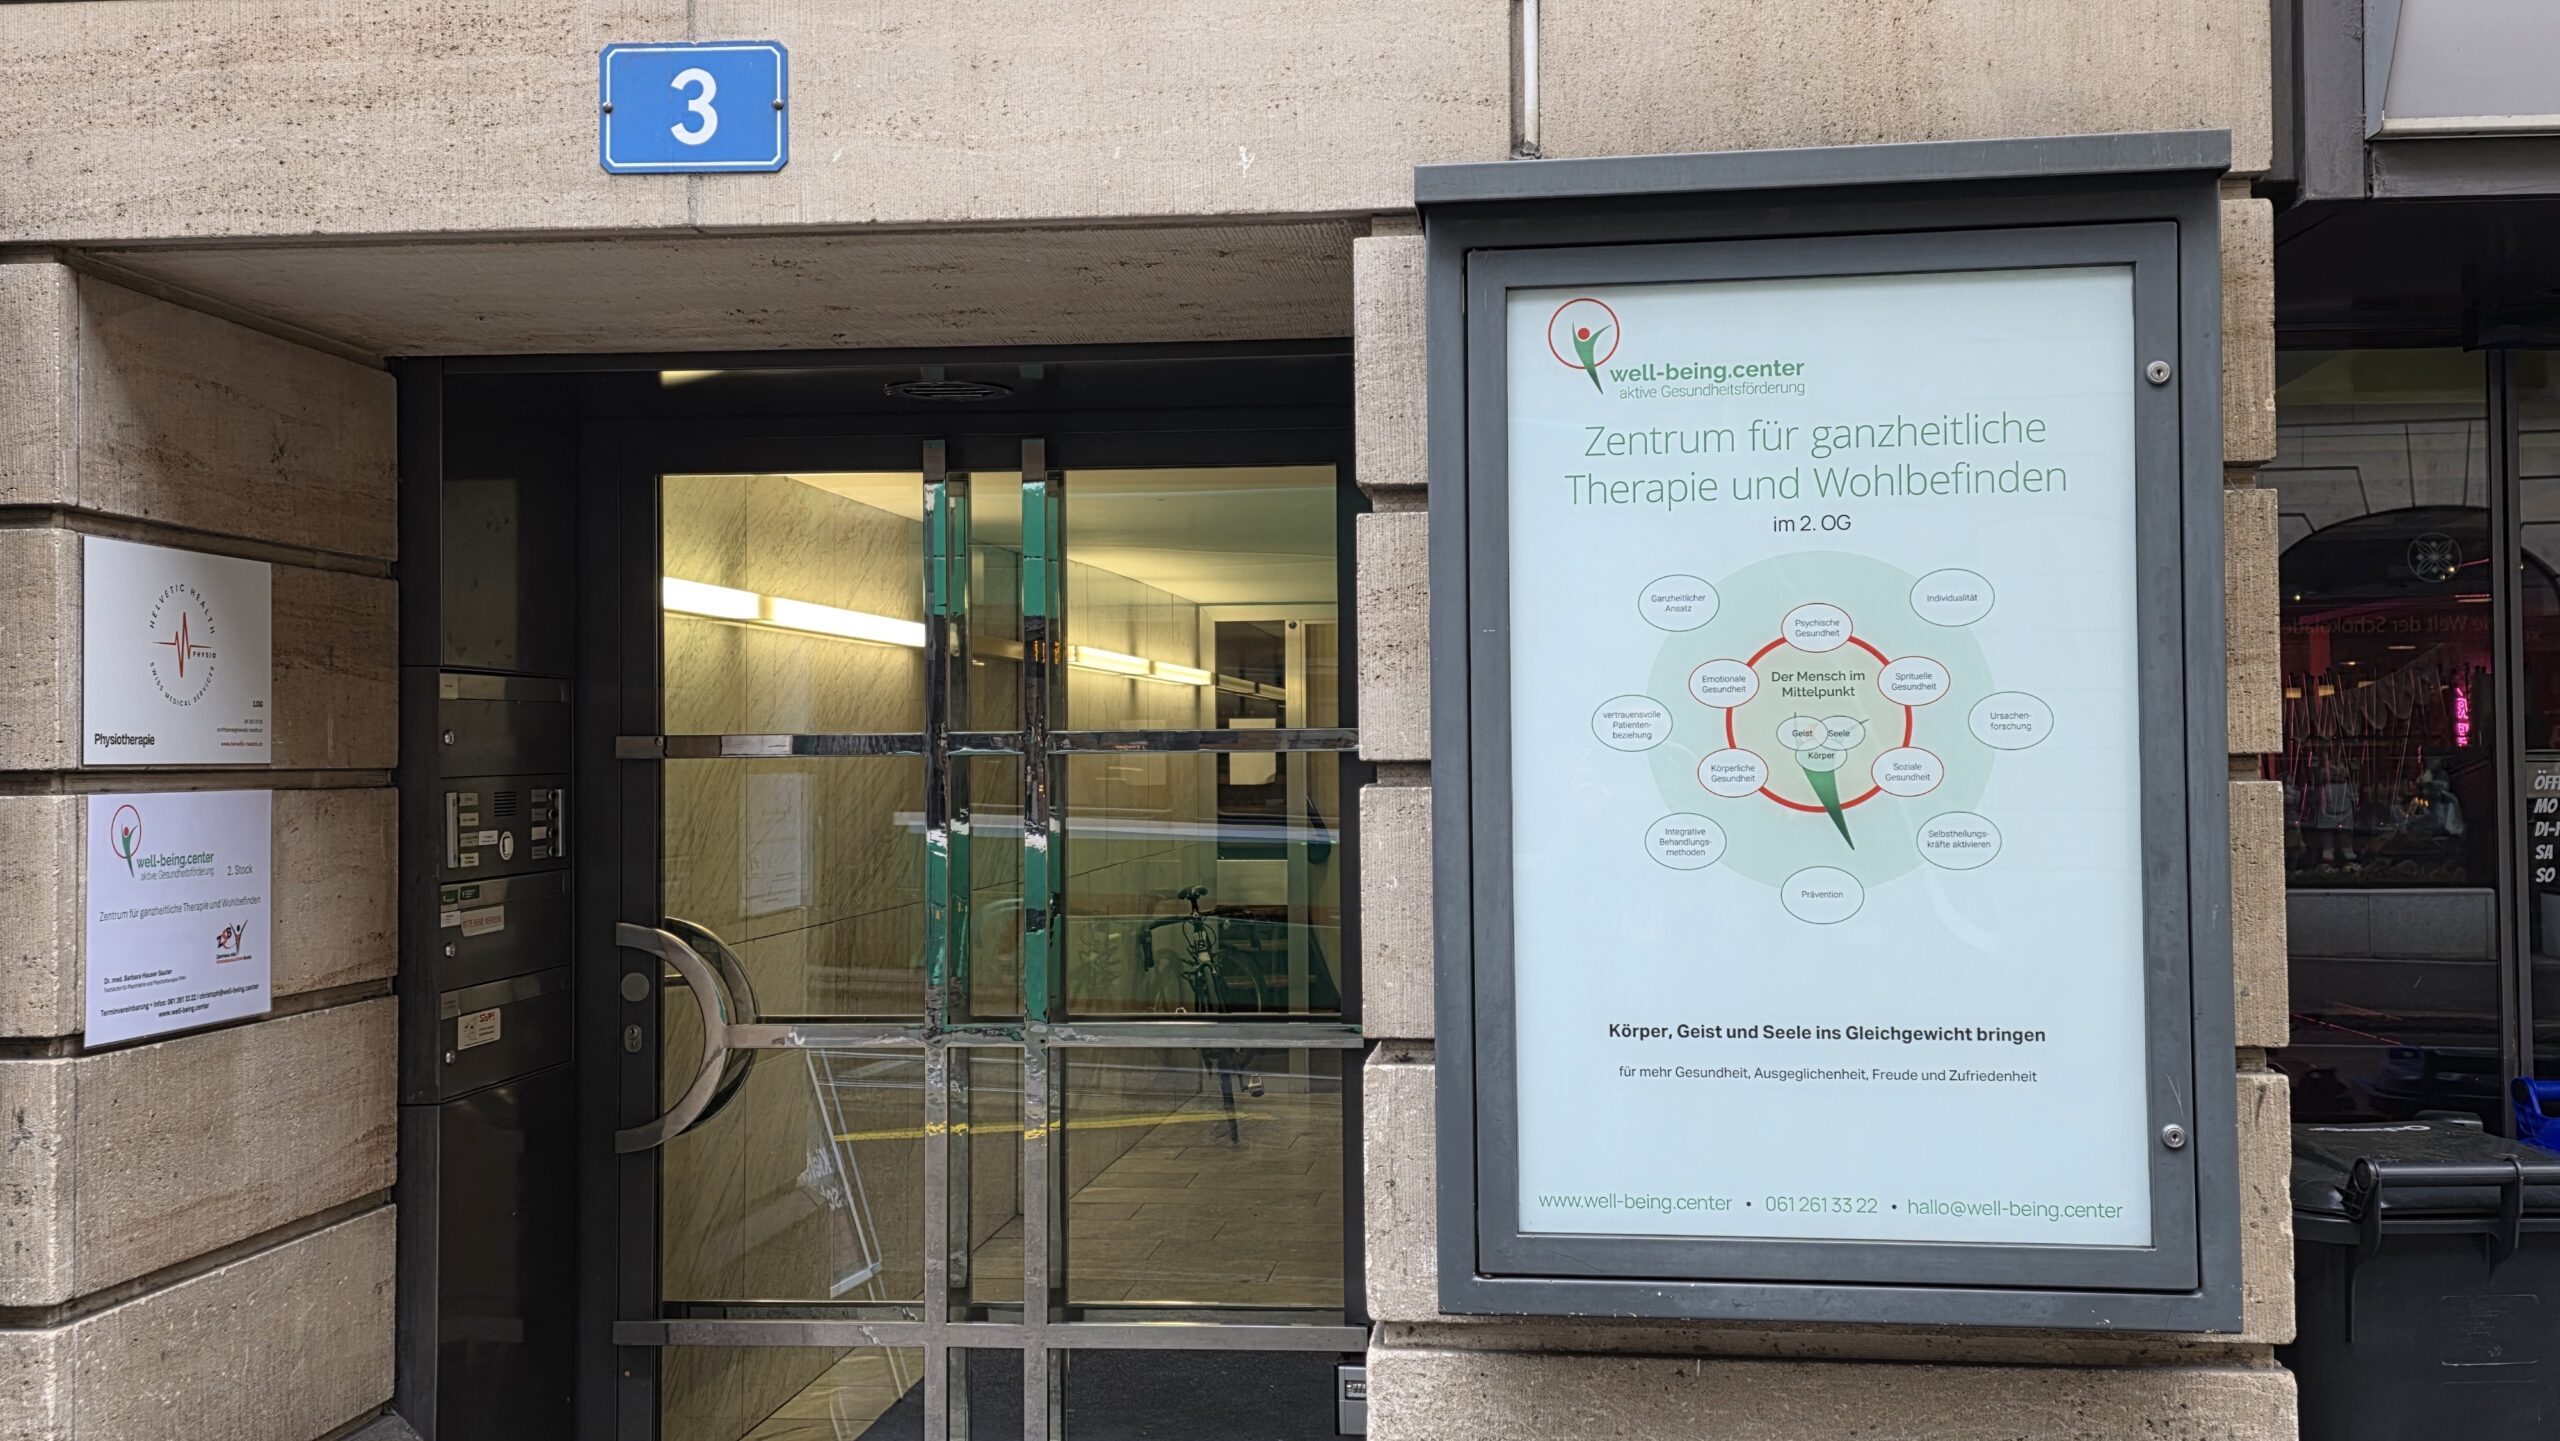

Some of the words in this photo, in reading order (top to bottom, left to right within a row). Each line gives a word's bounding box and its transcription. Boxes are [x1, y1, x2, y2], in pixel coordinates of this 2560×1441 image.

[671, 68, 718, 145] 3
[1610, 359, 1804, 383] well-being.center
[1619, 385, 1657, 399] aktive
[1660, 379, 1806, 398] Gesundheitsförderung
[1585, 425, 1734, 457] Zentrum
[1747, 418, 1800, 452] für
[1810, 411, 2047, 459] ganzheitliche
[1564, 471, 1719, 511] Therapie
[1732, 467, 1800, 501] und
[1813, 461, 2068, 500] Wohlbefinden
[1773, 515, 1796, 533] im
[1800, 515, 1817, 533] 2.
[1820, 514, 1852, 532] OG
[1651, 593, 1706, 603] Ganzheitlicher
[1927, 593, 1978, 602] Individualität
[149, 584, 185, 629] HELVETIC
[190, 587, 216, 634] HEALTH
[1665, 604, 1692, 612] Ansatz
[1795, 619, 1840, 628] Psychische
[1795, 629, 1840, 638] Gesundheit
[192, 651, 216, 659] PHYSIO
[1702, 675, 1746, 684] Emotionale
[1772, 672, 1793, 682] Der
[1797, 670, 1847, 682] Mensch
[1850, 670, 1865, 681] im
[1702, 685, 1746, 694] Gesundheit
[1891, 682, 1936, 692] Gesundheit
[1782, 686, 1855, 700] Mittelpunkt
[1603, 710, 1661, 719] vertrauensvolle
[1990, 712, 2032, 720] Ursachen-
[1613, 720, 1652, 730] Patienten-
[1990, 722, 2032, 732] forschung
[1612, 731, 1652, 741] beziehung
[1792, 729, 1813, 738] Geist
[1828, 729, 1850, 738] Seele
[94, 732, 156, 748] Physiotherapie
[1808, 751, 1835, 760] Körper
[1711, 764, 1755, 774] Körperliche
[1893, 762, 1922, 771] Soziale
[1711, 774, 1755, 783] Gesundheit
[1885, 772, 1930, 782] Gesundheit
[2534, 798, 2558, 814] MO
[1665, 828, 1706, 837] Integrative
[1928, 830, 1990, 839] Selbstheilungs-
[1659, 838, 1712, 847] Behandlungs-
[1927, 840, 1950, 848] kräfte
[1952, 840, 1991, 848] aktivieren
[1666, 848, 1706, 857] methoden
[2535, 844, 2554, 860] SA
[136, 852, 214, 869] well-being.center
[234, 864, 253, 876] Stock
[2536, 867, 2556, 882] SO
[1801, 890, 1844, 899] Prävention
[100, 911, 128, 922] Zentrum
[130, 907, 139, 918] für
[140, 904, 182, 919] ganzheitliche
[184, 901, 208, 912] Therapie
[210, 898, 221, 910] und
[222, 896, 261, 907] Wohlbefinden
[101, 1003, 150, 1016] Terminvereinbarung
[1609, 1024, 1672, 1041] Körper,
[1677, 1024, 1722, 1038] Geist
[1726, 1024, 1758, 1039] und
[1762, 1025, 1812, 1040] Seele
[1816, 1026, 1841, 1040] ins
[1846, 1026, 1972, 1044] Gleichgewicht
[1977, 1027, 2046, 1044] bringen
[1619, 1066, 1637, 1078] für
[1640, 1066, 1672, 1078] mehr
[1676, 1066, 1750, 1080] Gesundheit,
[1754, 1067, 1868, 1082] Ausgeglichenheit,
[1872, 1068, 1918, 1081] Freude
[1921, 1069, 1946, 1082] und
[1949, 1070, 2038, 1082] Zufriedenheit
[1539, 1193, 1732, 1214] www.well-being.center
[1764, 1196, 1795, 1212] 061
[1799, 1197, 1829, 1213] 261
[1831, 1197, 1854, 1214] 33
[1856, 1198, 1878, 1214] 22
[1907, 1199, 2123, 1222] hallo@well-being.center
